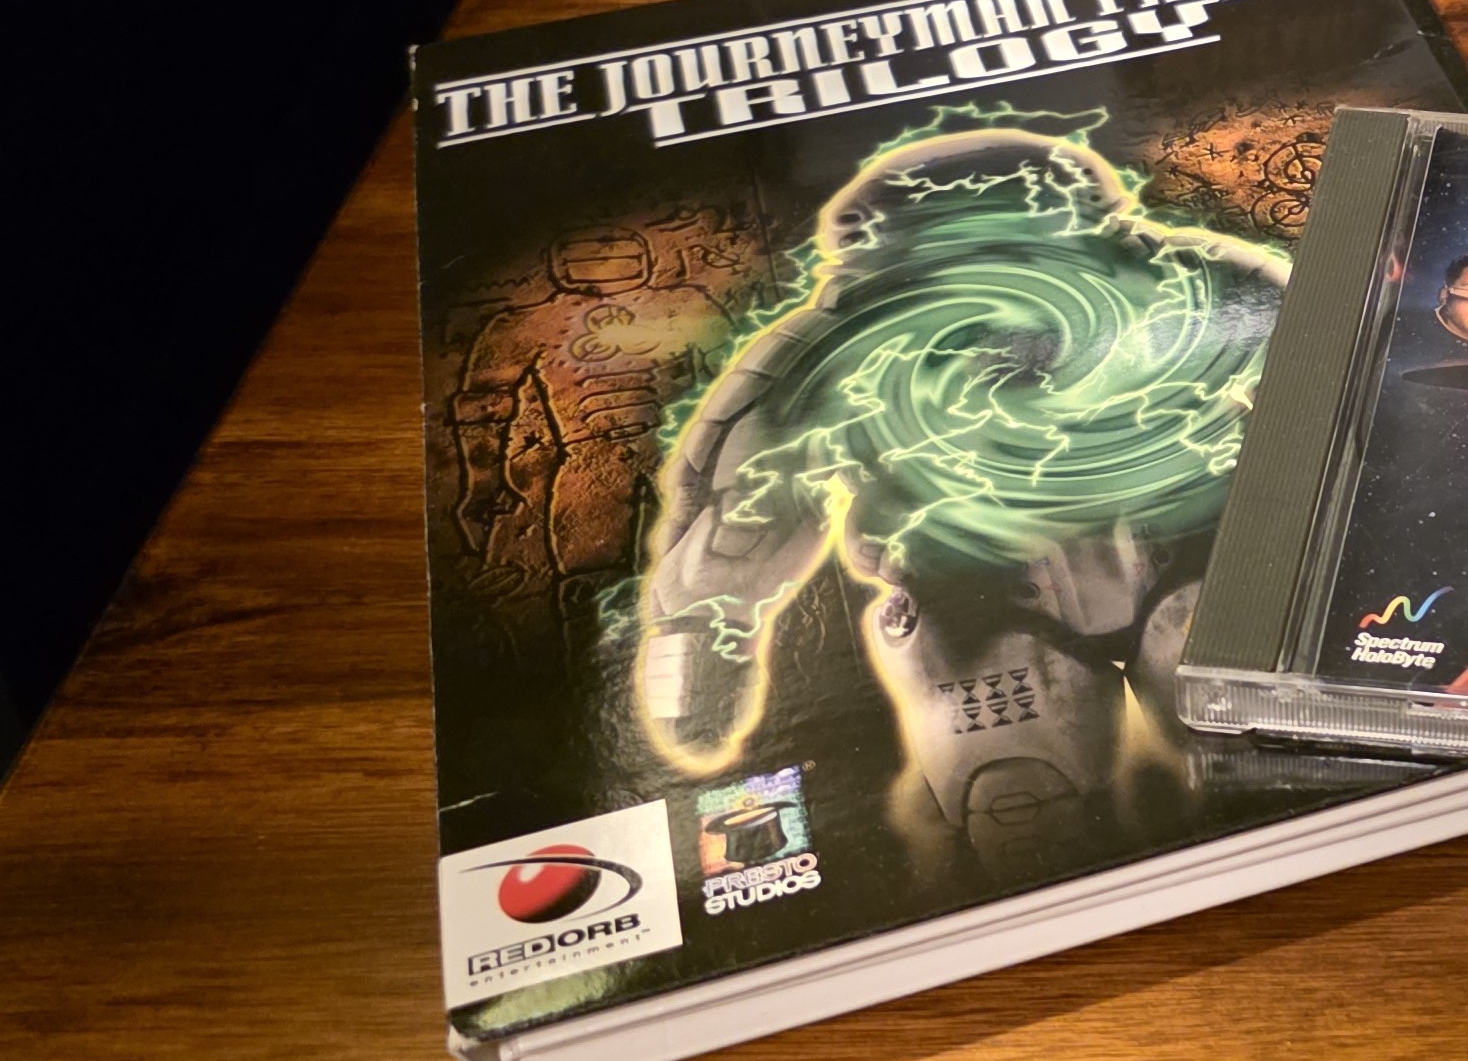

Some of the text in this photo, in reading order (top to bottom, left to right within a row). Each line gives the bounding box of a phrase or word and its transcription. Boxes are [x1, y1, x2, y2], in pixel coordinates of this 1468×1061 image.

[436, 69, 578, 137] THE
[1350, 646, 1437, 670] HoloByte
[1353, 631, 1446, 655] Spectrum
[702, 853, 819, 899] PRESTO
[704, 870, 823, 917] STUDIOS
[469, 933, 642, 988] entertainment
